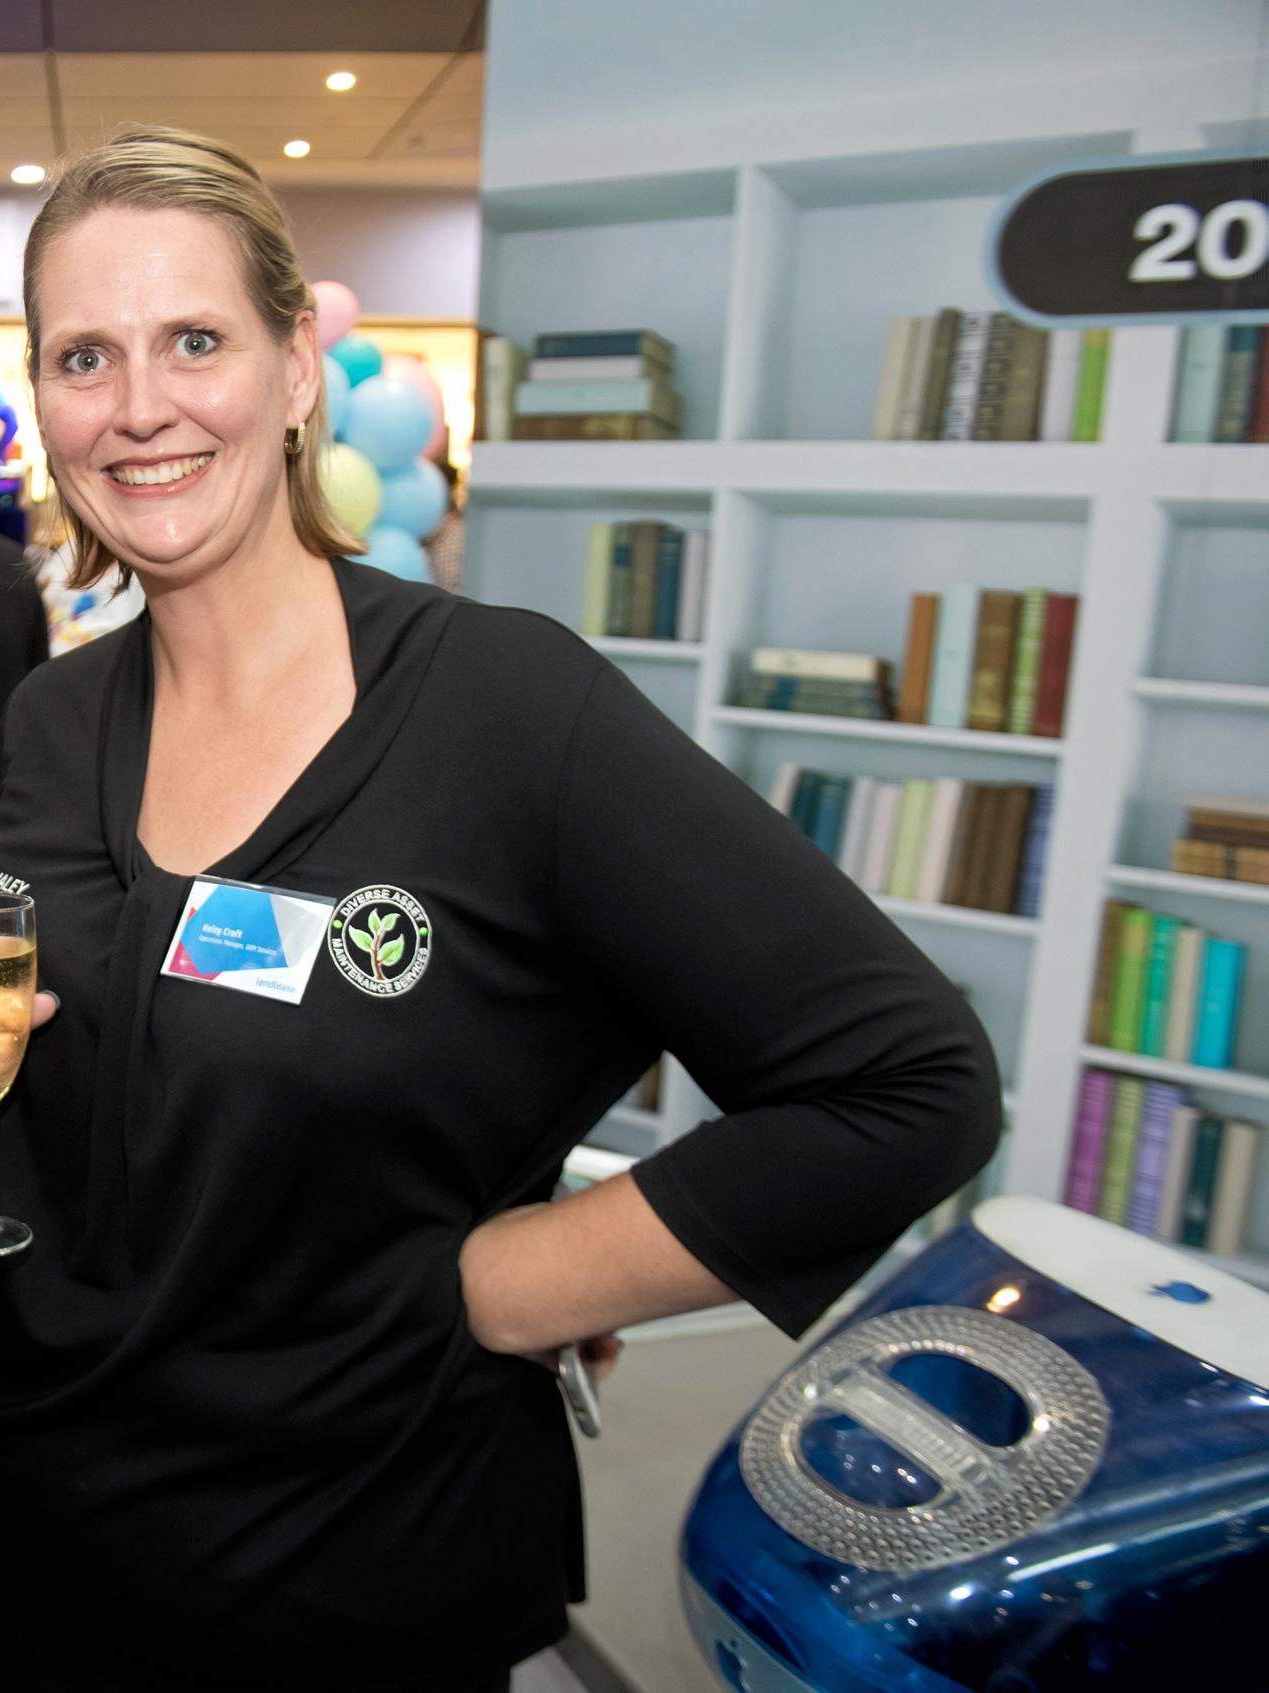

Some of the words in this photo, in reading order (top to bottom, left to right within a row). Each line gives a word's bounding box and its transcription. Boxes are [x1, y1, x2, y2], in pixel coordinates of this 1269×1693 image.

[1128, 199, 1269, 282] 20
[340, 889, 392, 917] DIVERSE
[391, 891, 425, 921] ASSET
[331, 938, 394, 993] MAINTENANCE
[393, 947, 429, 990] SERVICES
